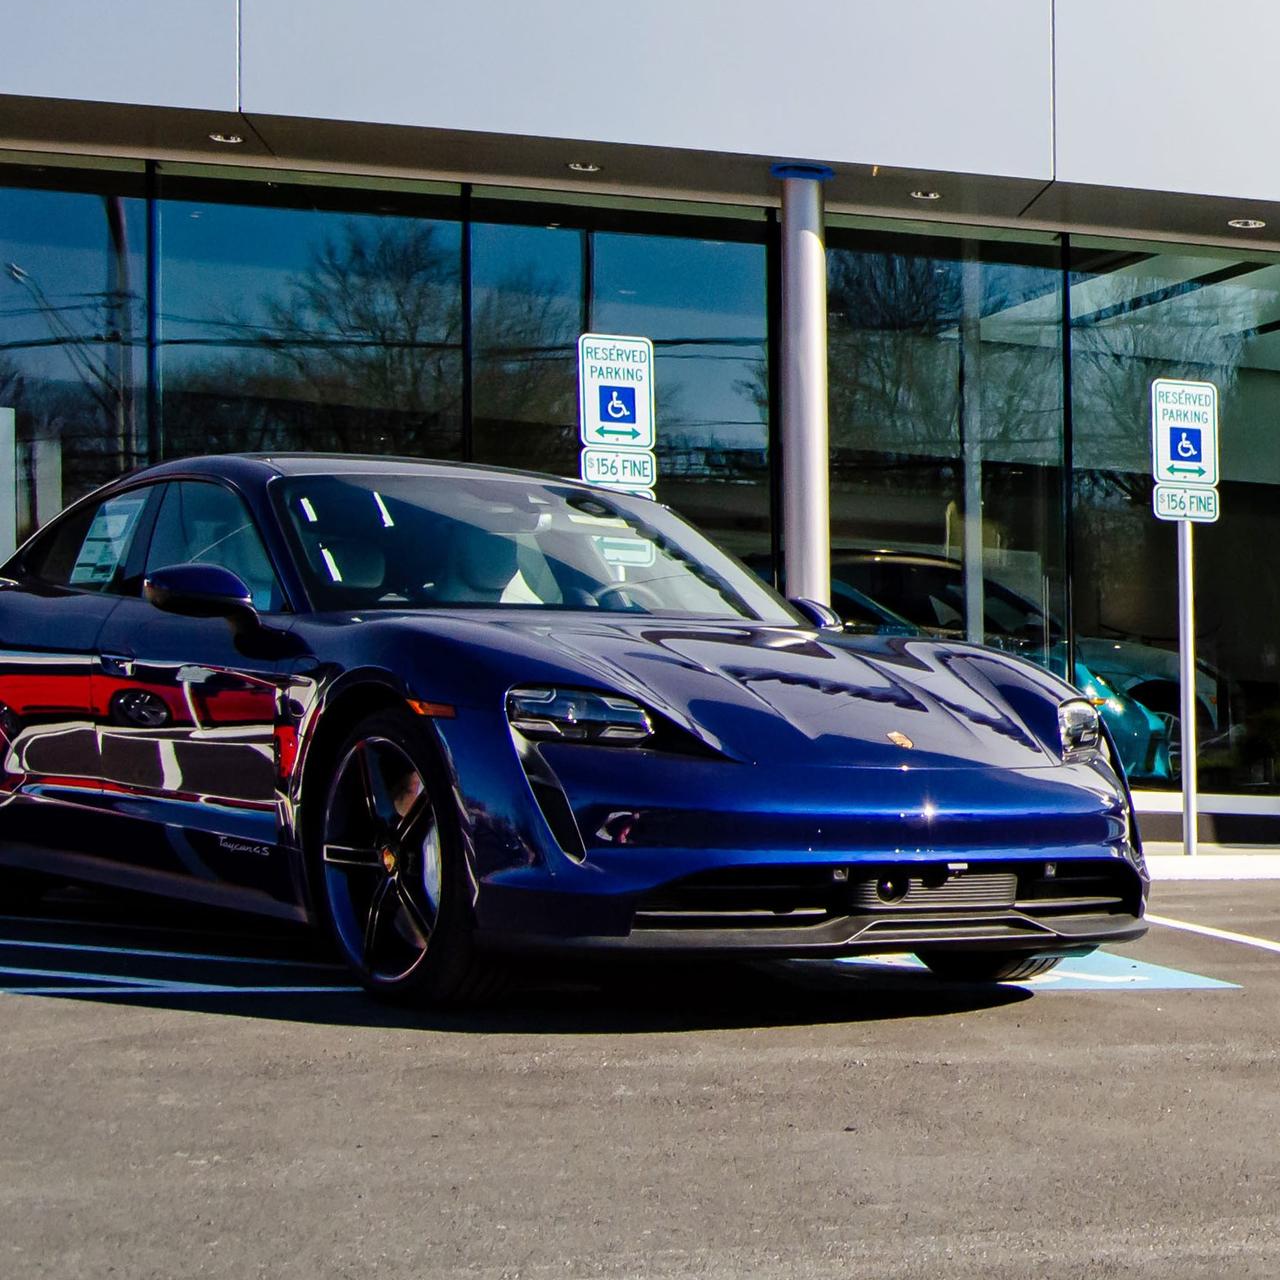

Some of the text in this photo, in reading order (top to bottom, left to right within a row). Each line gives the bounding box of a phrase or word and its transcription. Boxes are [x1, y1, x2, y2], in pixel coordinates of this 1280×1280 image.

[585, 346, 647, 364] RESERVED
[590, 365, 643, 382] PARKING
[1158, 390, 1212, 408] RESERVED
[1162, 408, 1208, 424] PARKING
[622, 459, 650, 478] FINE
[1189, 495, 1214, 513] FINE
